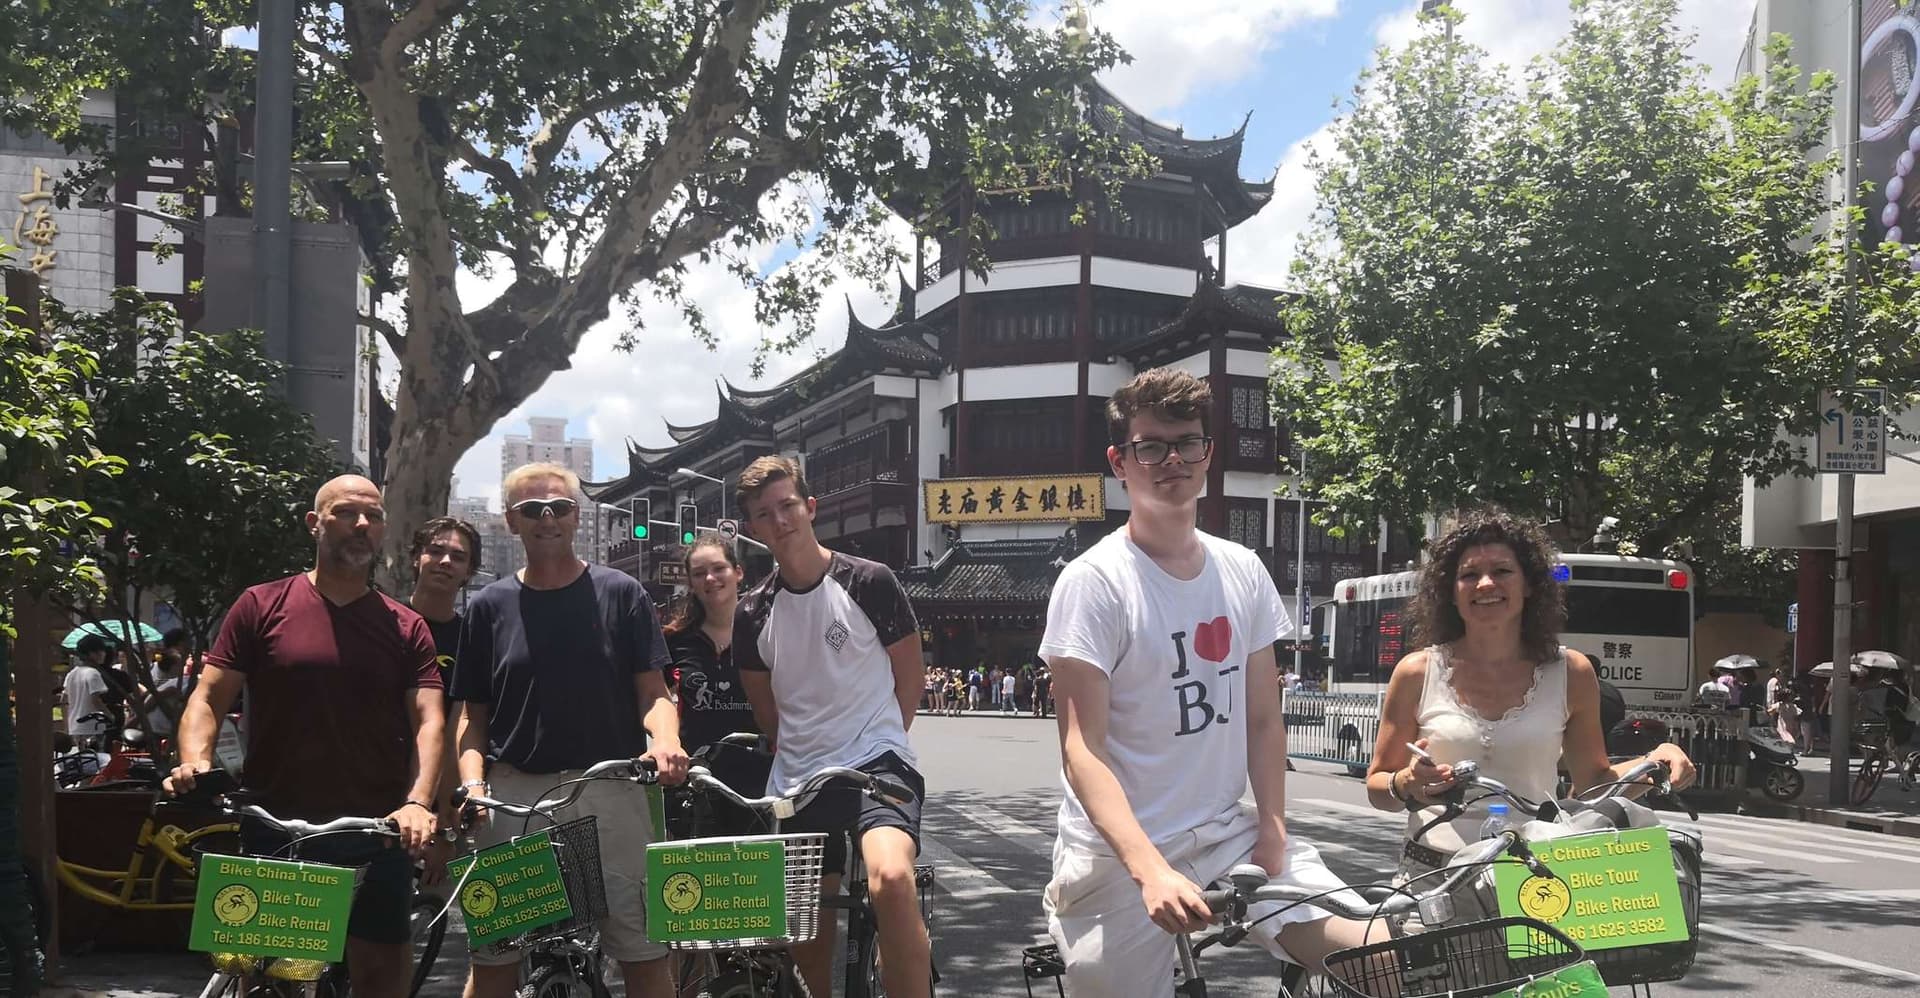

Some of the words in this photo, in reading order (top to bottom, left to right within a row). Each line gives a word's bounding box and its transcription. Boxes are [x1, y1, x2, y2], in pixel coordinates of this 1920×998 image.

[1171, 631, 1189, 679] I
[1603, 641, 1632, 659] 警察
[1599, 665, 1643, 681] OLICE
[1174, 665, 1240, 736] BJ
[481, 850, 516, 868] China
[517, 839, 551, 855] Tours
[662, 853, 691, 865] Bike
[695, 850, 731, 864] China
[735, 848, 771, 861] Tours
[1553, 845, 1601, 862] China
[1604, 838, 1651, 855] Tours
[219, 862, 252, 876] Bike
[256, 866, 296, 882] China
[300, 870, 339, 885] Tours
[495, 871, 520, 888] Bike
[520, 863, 545, 879] Tour
[704, 873, 730, 887] Bike
[732, 872, 758, 886] Tour
[1569, 871, 1603, 890] Bike
[1606, 867, 1641, 885] Tour
[262, 889, 291, 905] Bike
[294, 892, 321, 908] Tour
[501, 890, 526, 908] Bike
[526, 878, 563, 900] Rental
[704, 897, 730, 911] Bike
[732, 895, 770, 910] Rental
[1574, 899, 1609, 917] Bike
[1611, 892, 1661, 912] Rental
[258, 913, 287, 928] Bike
[289, 915, 330, 932] Rental
[473, 923, 493, 937] Tel:
[493, 915, 513, 931] 186
[514, 907, 541, 924] 1625
[540, 897, 569, 915] 3582
[666, 920, 685, 933] Tel:
[688, 918, 710, 930] 186
[712, 917, 740, 930] 1625
[743, 916, 771, 929] 3582
[1562, 925, 1586, 942] 86
[1590, 921, 1627, 939] 1625
[1630, 916, 1666, 933] 3582
[213, 930, 233, 944] Tel:
[237, 933, 261, 945] 186
[263, 934, 295, 948] 1625
[297, 938, 329, 952] 3582
